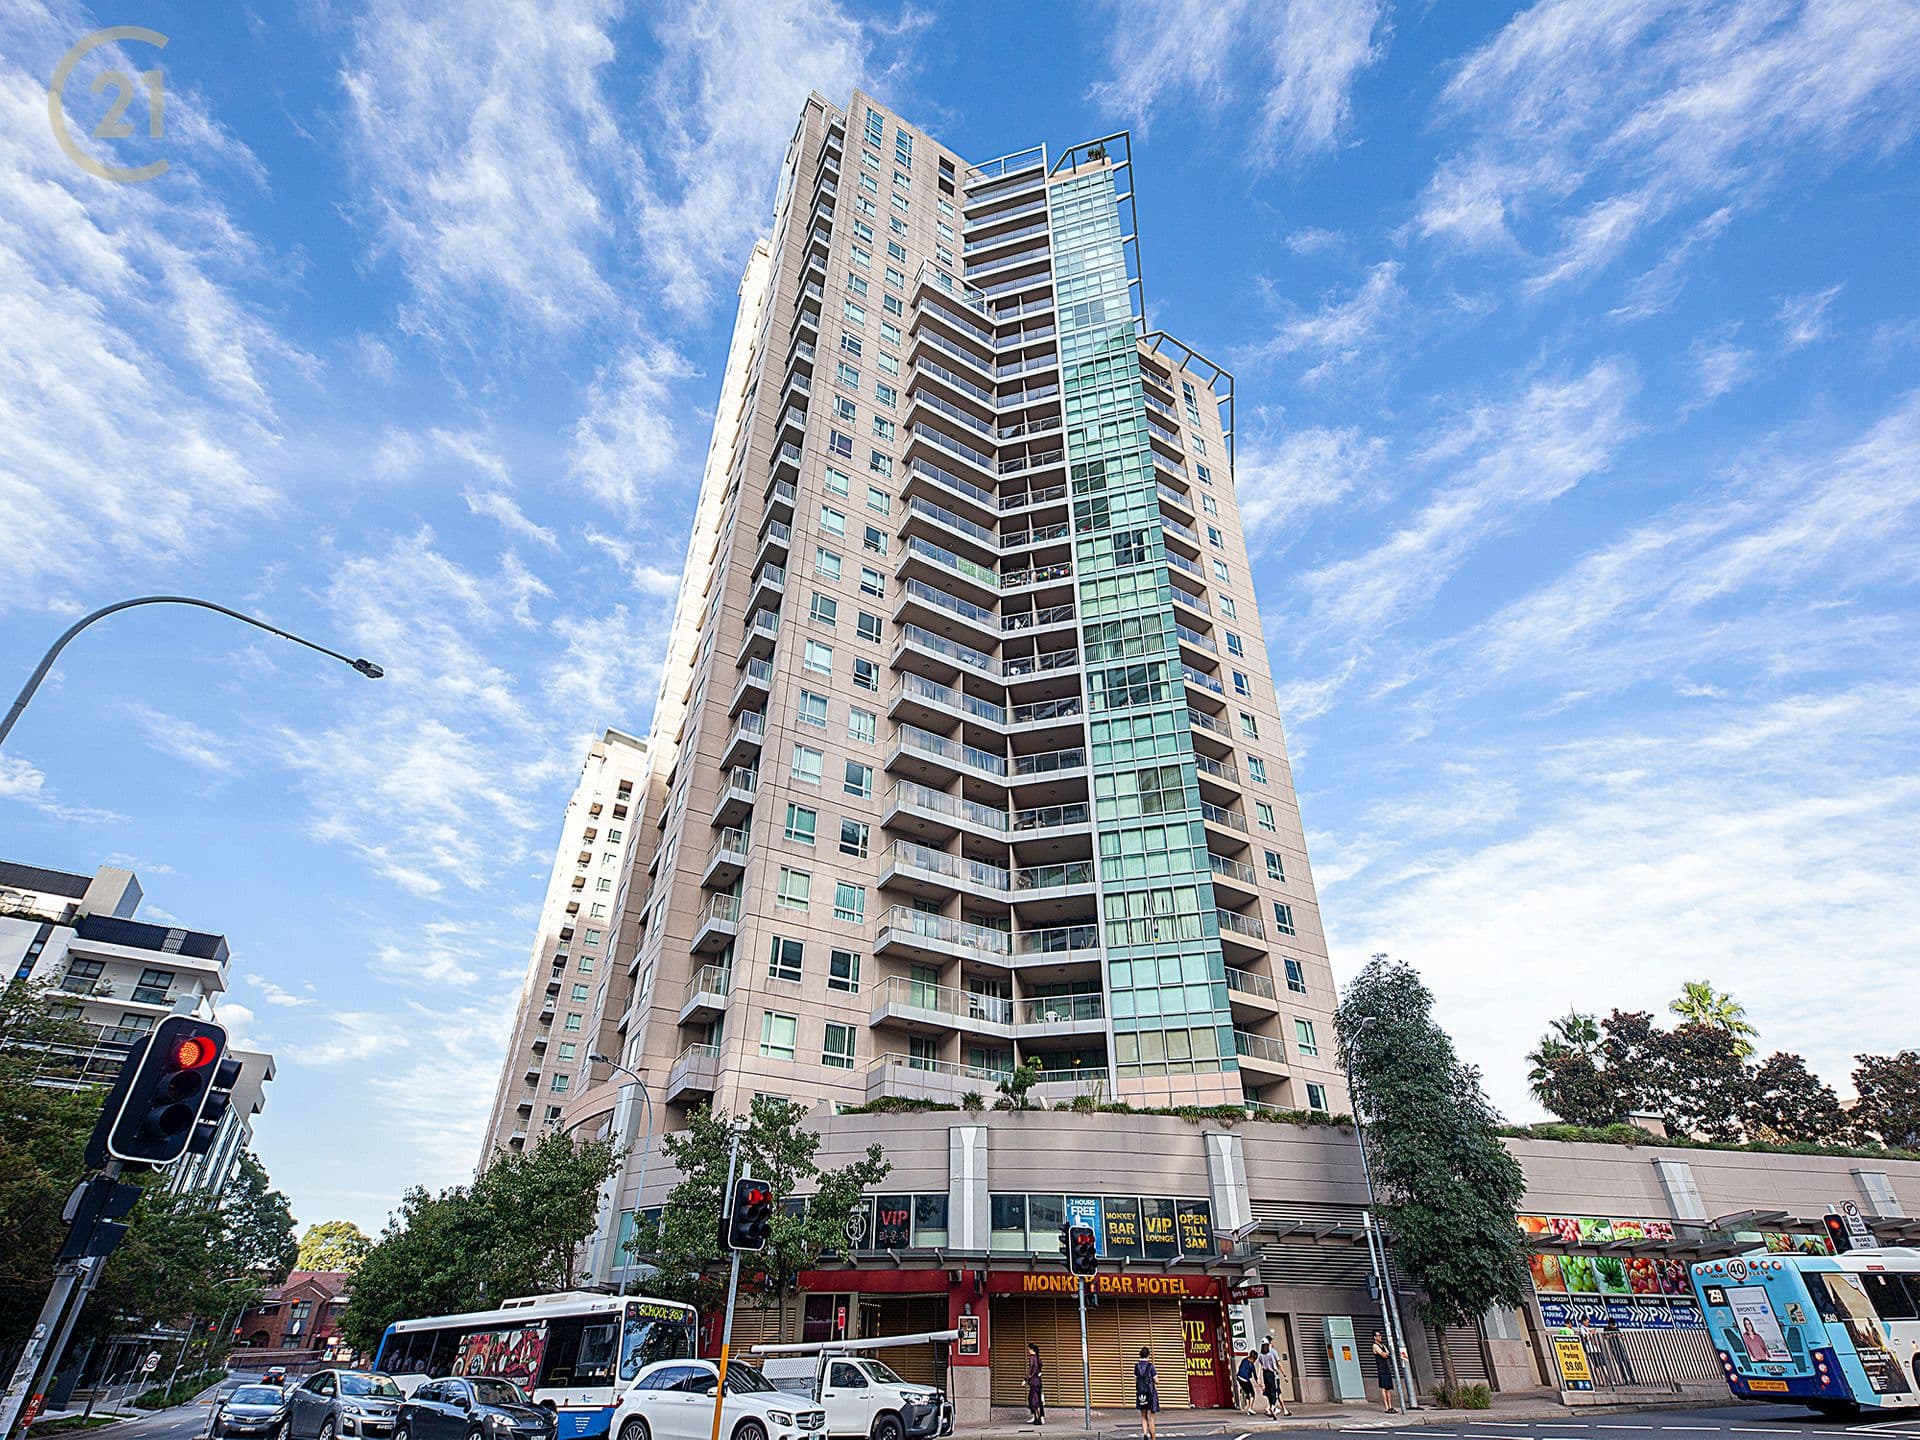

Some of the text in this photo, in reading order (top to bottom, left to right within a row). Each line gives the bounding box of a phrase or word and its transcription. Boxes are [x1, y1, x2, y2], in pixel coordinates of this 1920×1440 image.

[1071, 1206, 1096, 1216] FREE
[1106, 1212, 1136, 1220] MONKEY
[880, 1210, 908, 1226] VIP
[1179, 1214, 1208, 1225] OPEN
[1109, 1222, 1135, 1235] BAR
[1144, 1217, 1172, 1233] VIP
[1183, 1225, 1207, 1237] TILL
[1111, 1237, 1135, 1245] HOTEL
[1145, 1234, 1175, 1243] LOUNGE
[1185, 1237, 1208, 1249] 3AM
[1730, 1263, 1744, 1275] 40
[1100, 1276, 1133, 1293] BAR
[1136, 1277, 1189, 1294] HOTEL
[639, 1303, 667, 1320] SCHOOL
[1182, 1321, 1205, 1341] VIP
[1187, 1357, 1212, 1369] NTRY
